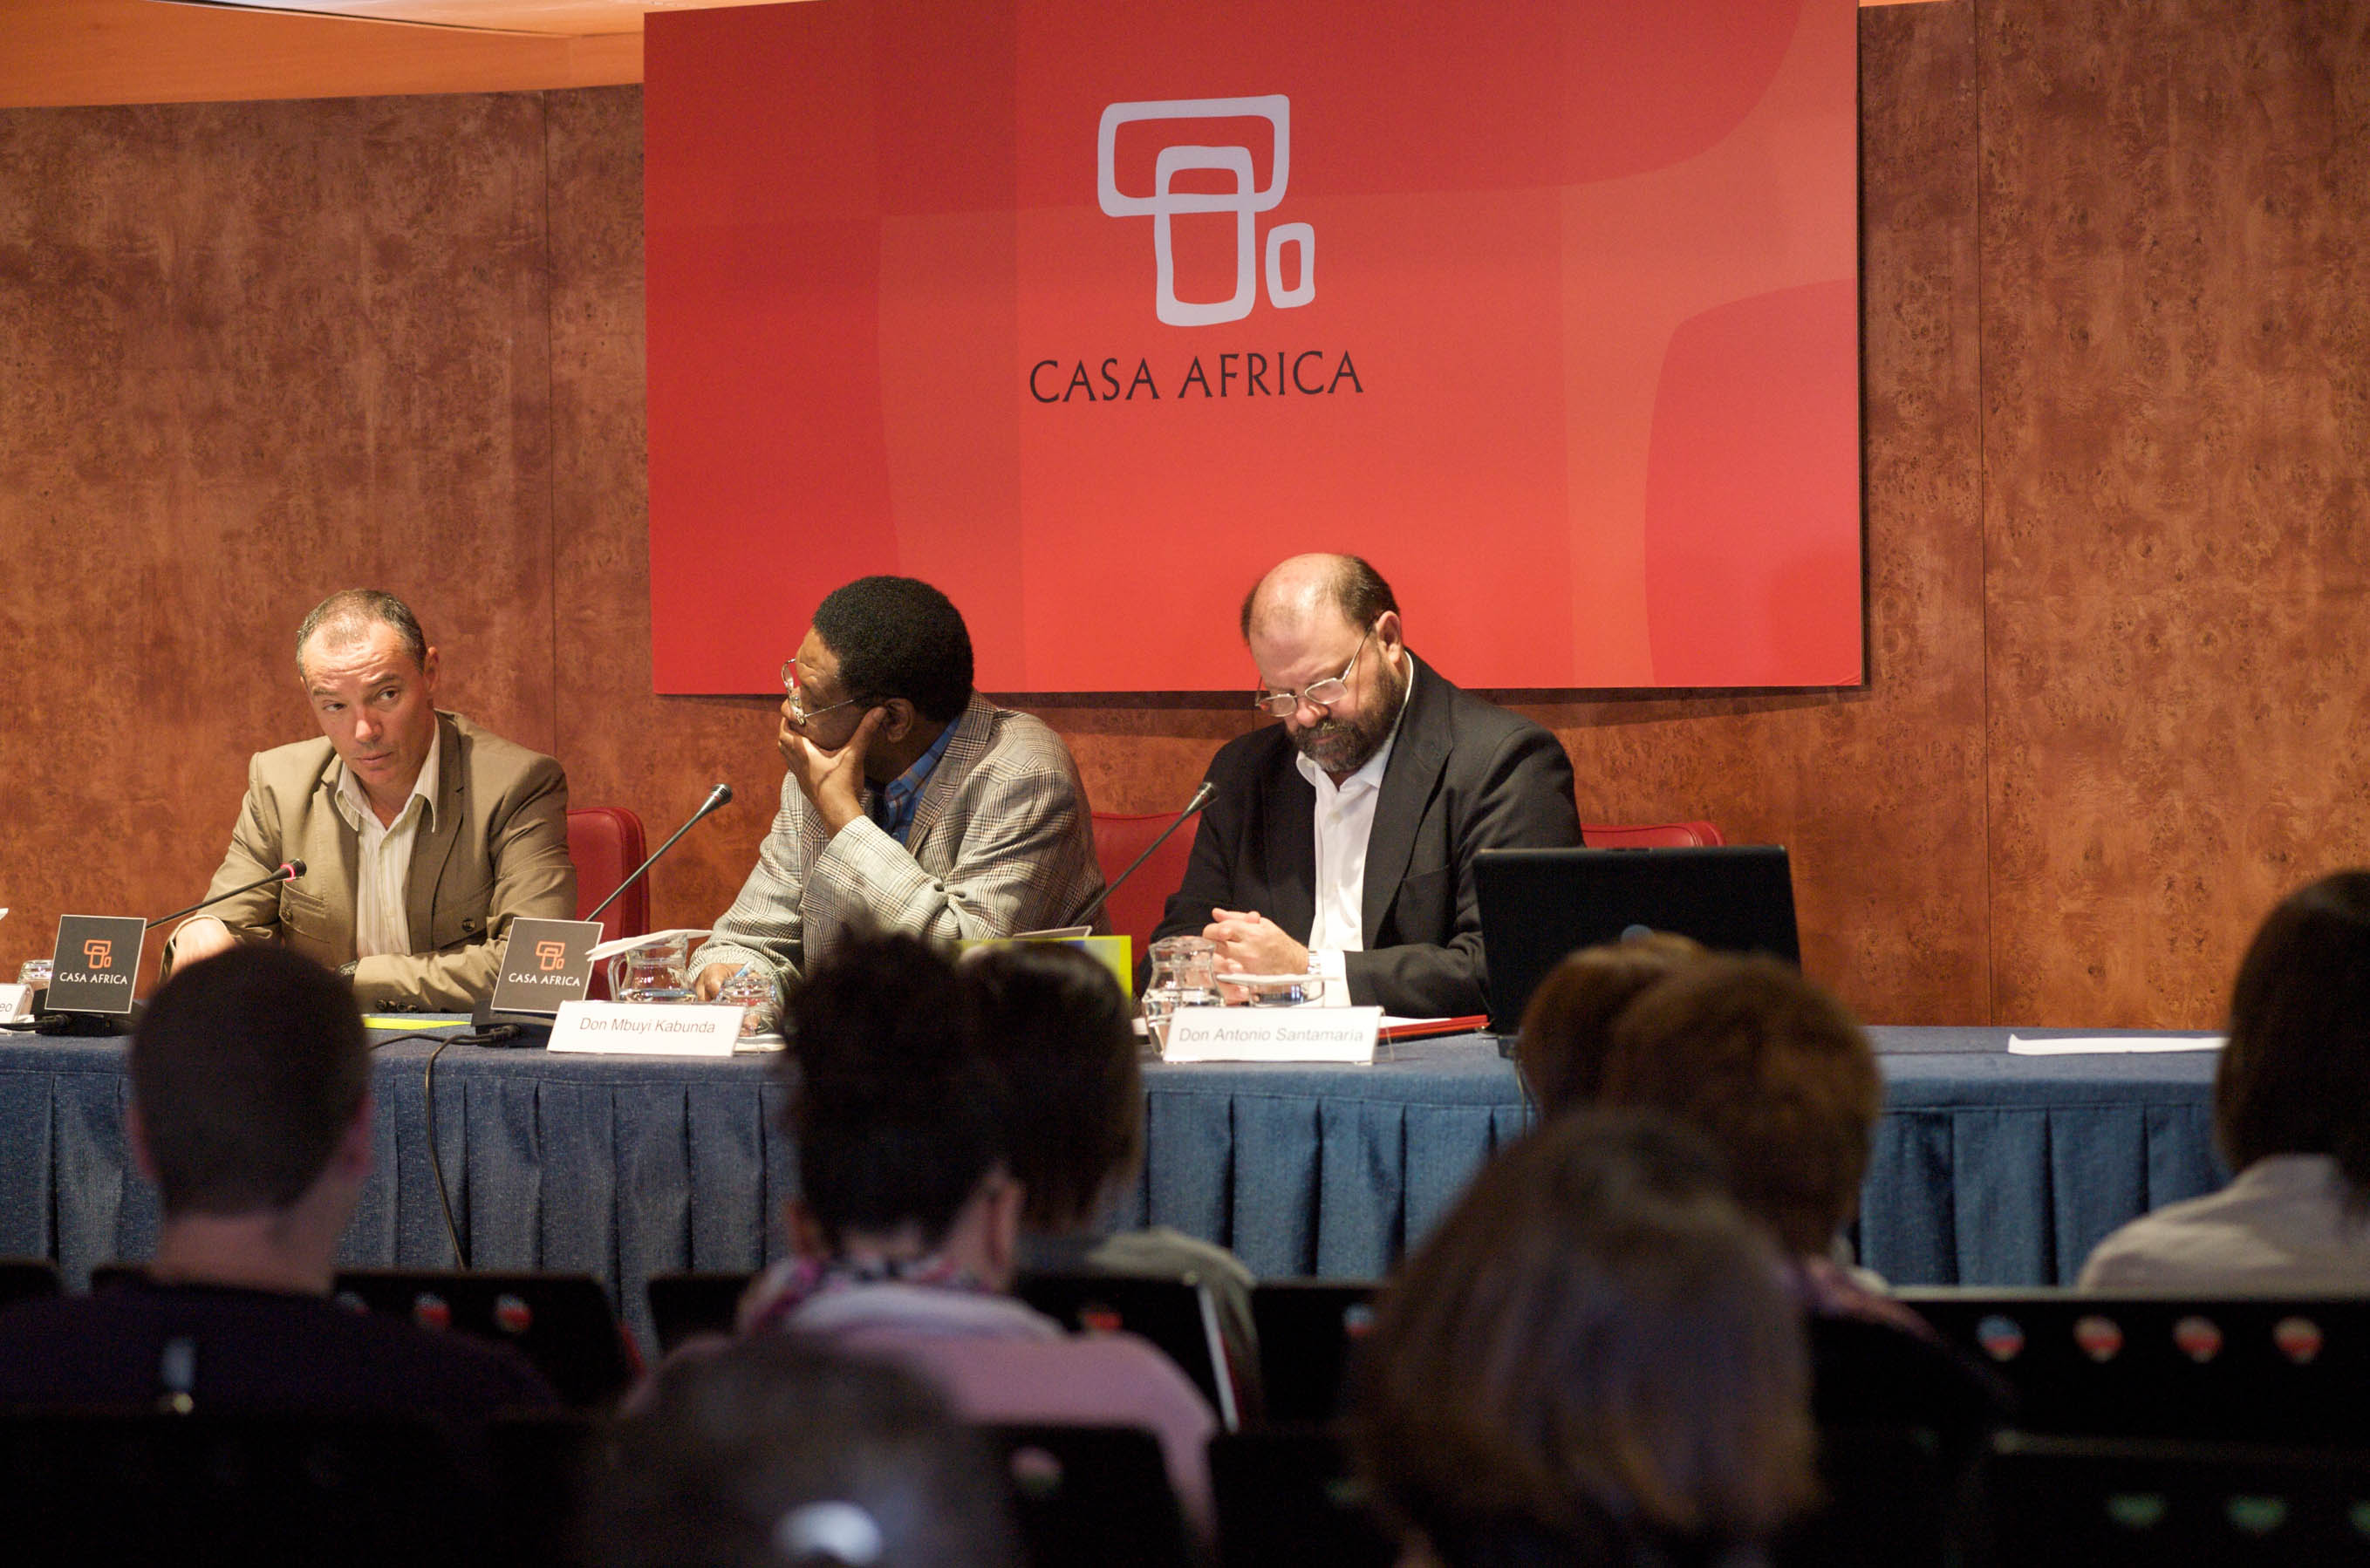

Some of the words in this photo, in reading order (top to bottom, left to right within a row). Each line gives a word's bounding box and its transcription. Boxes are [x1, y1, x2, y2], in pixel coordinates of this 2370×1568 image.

[1029, 358, 1161, 403] CASA
[1178, 350, 1363, 399] AFRICA
[59, 971, 87, 983] CASA
[90, 973, 127, 985] AFRICA
[509, 972, 537, 984] CASA
[540, 974, 580, 986] AFRICA
[579, 1017, 607, 1031] Don
[611, 1018, 652, 1034] Mbuyi
[655, 1019, 716, 1033] Kabunda
[1178, 1027, 1209, 1042] Don
[1213, 1027, 1271, 1042] Antonio
